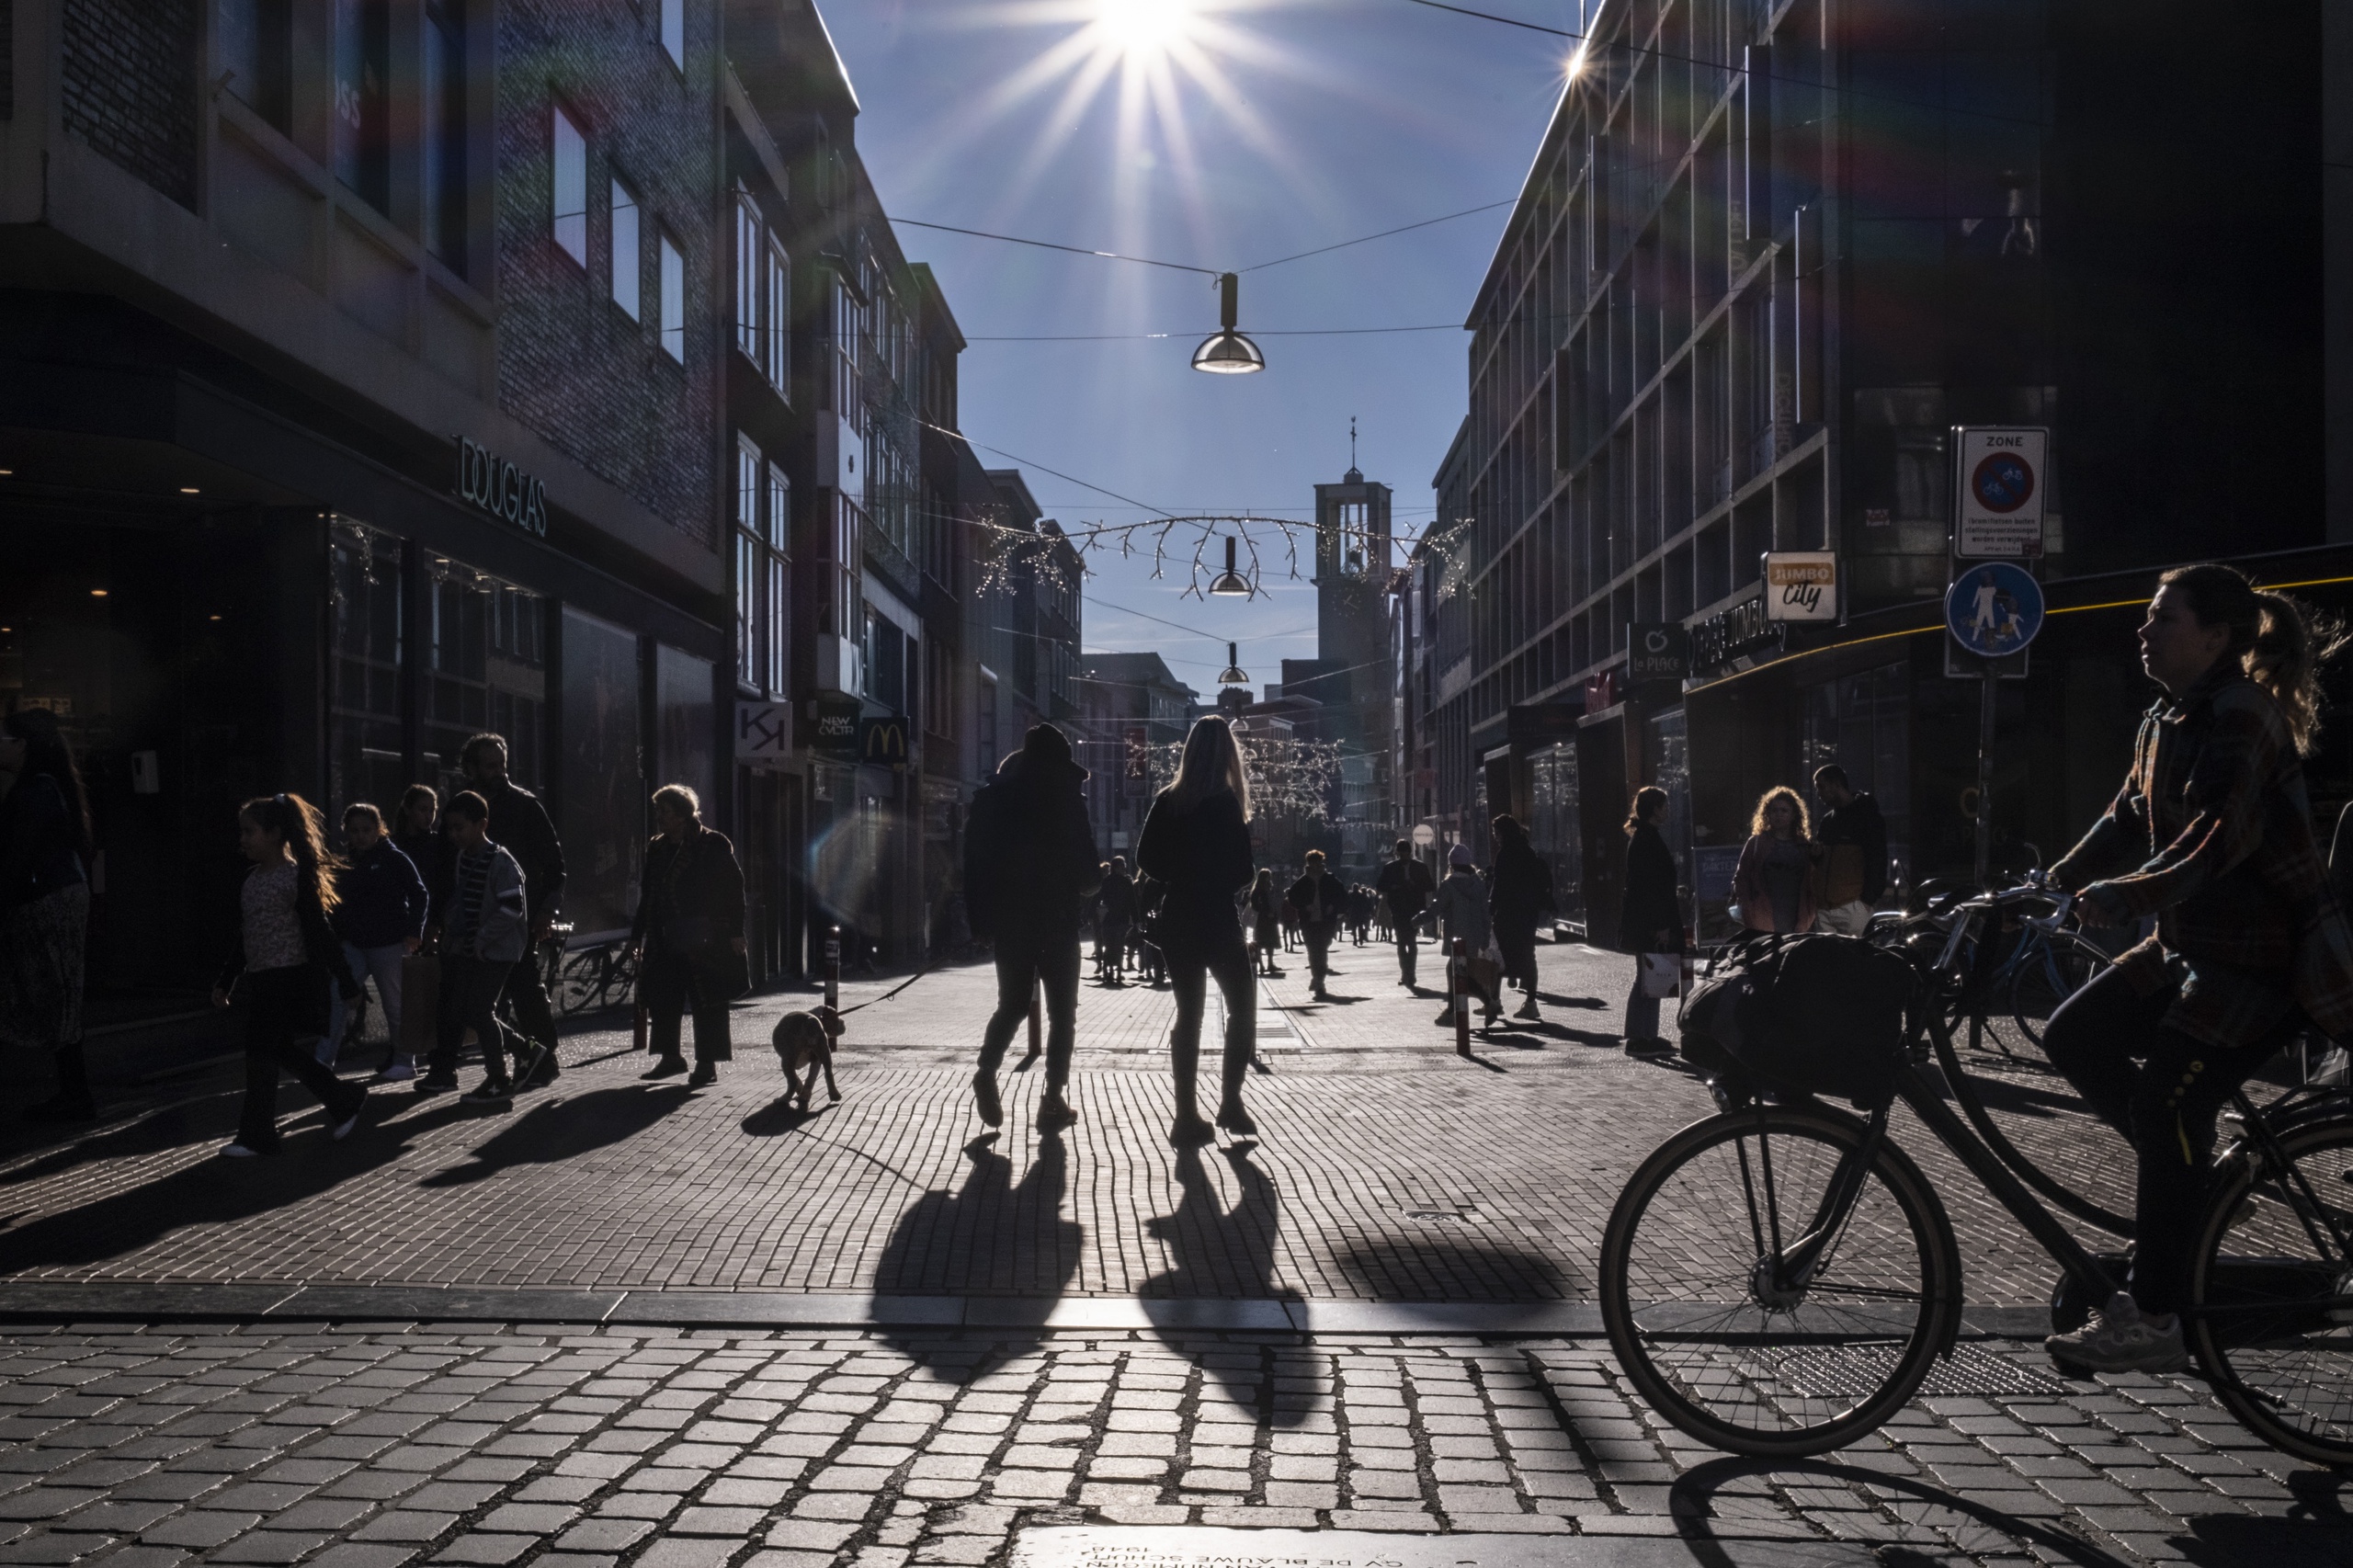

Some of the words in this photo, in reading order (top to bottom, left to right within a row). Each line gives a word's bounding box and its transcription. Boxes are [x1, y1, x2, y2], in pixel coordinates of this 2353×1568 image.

[1986, 437, 2023, 447] ZONE
[461, 436, 546, 538] DOUGLAS
[2014, 517, 2036, 525] buiten
[1776, 567, 1829, 580] JUMBO
[1647, 656, 1679, 672] PLACE
[822, 716, 850, 726] NEW
[1196, 1555, 1307, 1565] BLAUWE
